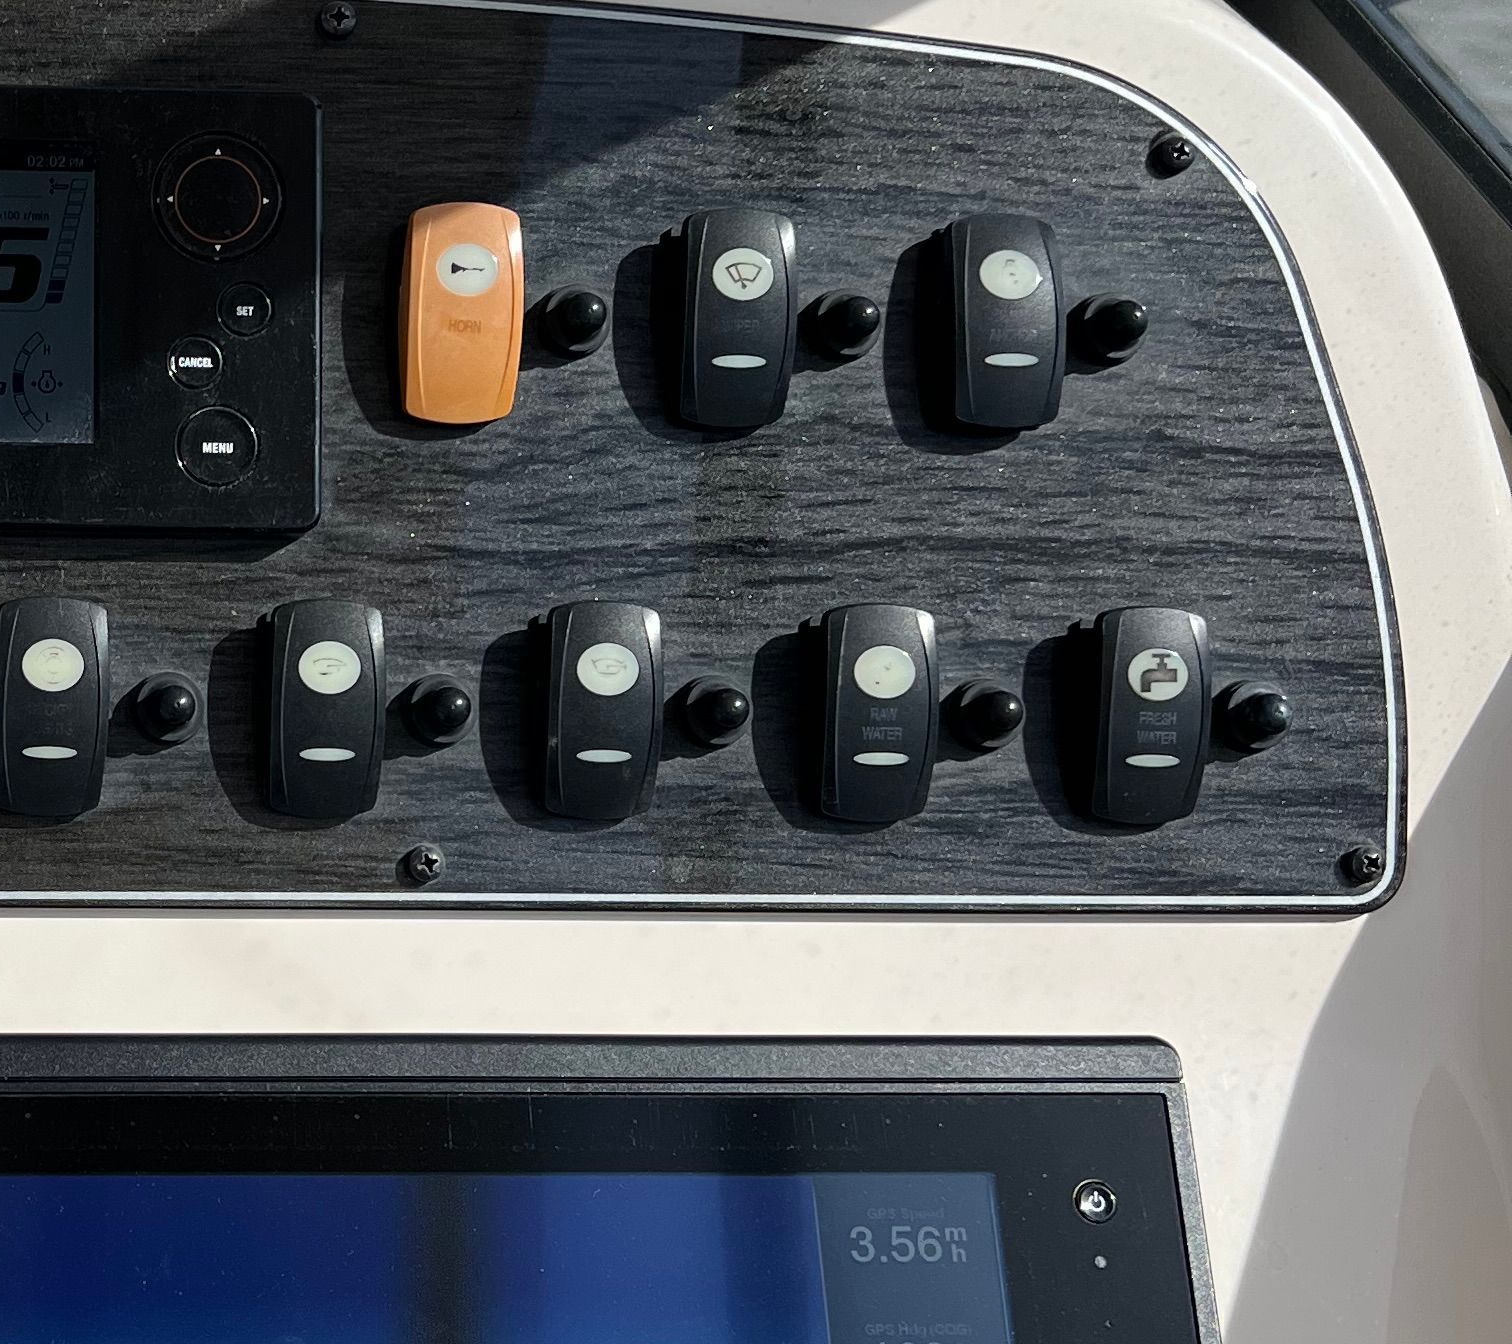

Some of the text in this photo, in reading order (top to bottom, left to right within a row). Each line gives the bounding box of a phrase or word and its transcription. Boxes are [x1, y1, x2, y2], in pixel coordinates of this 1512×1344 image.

[27, 155, 66, 168] 02:02
[236, 306, 254, 316] SET
[448, 320, 482, 334] HORN
[178, 357, 214, 368] CANCEL
[202, 442, 234, 454] MENU
[870, 708, 898, 720] RAW
[1139, 712, 1177, 726] FRESH
[862, 726, 903, 740] WATER
[1137, 731, 1177, 745] WATER
[849, 1226, 943, 1264] 3.56
